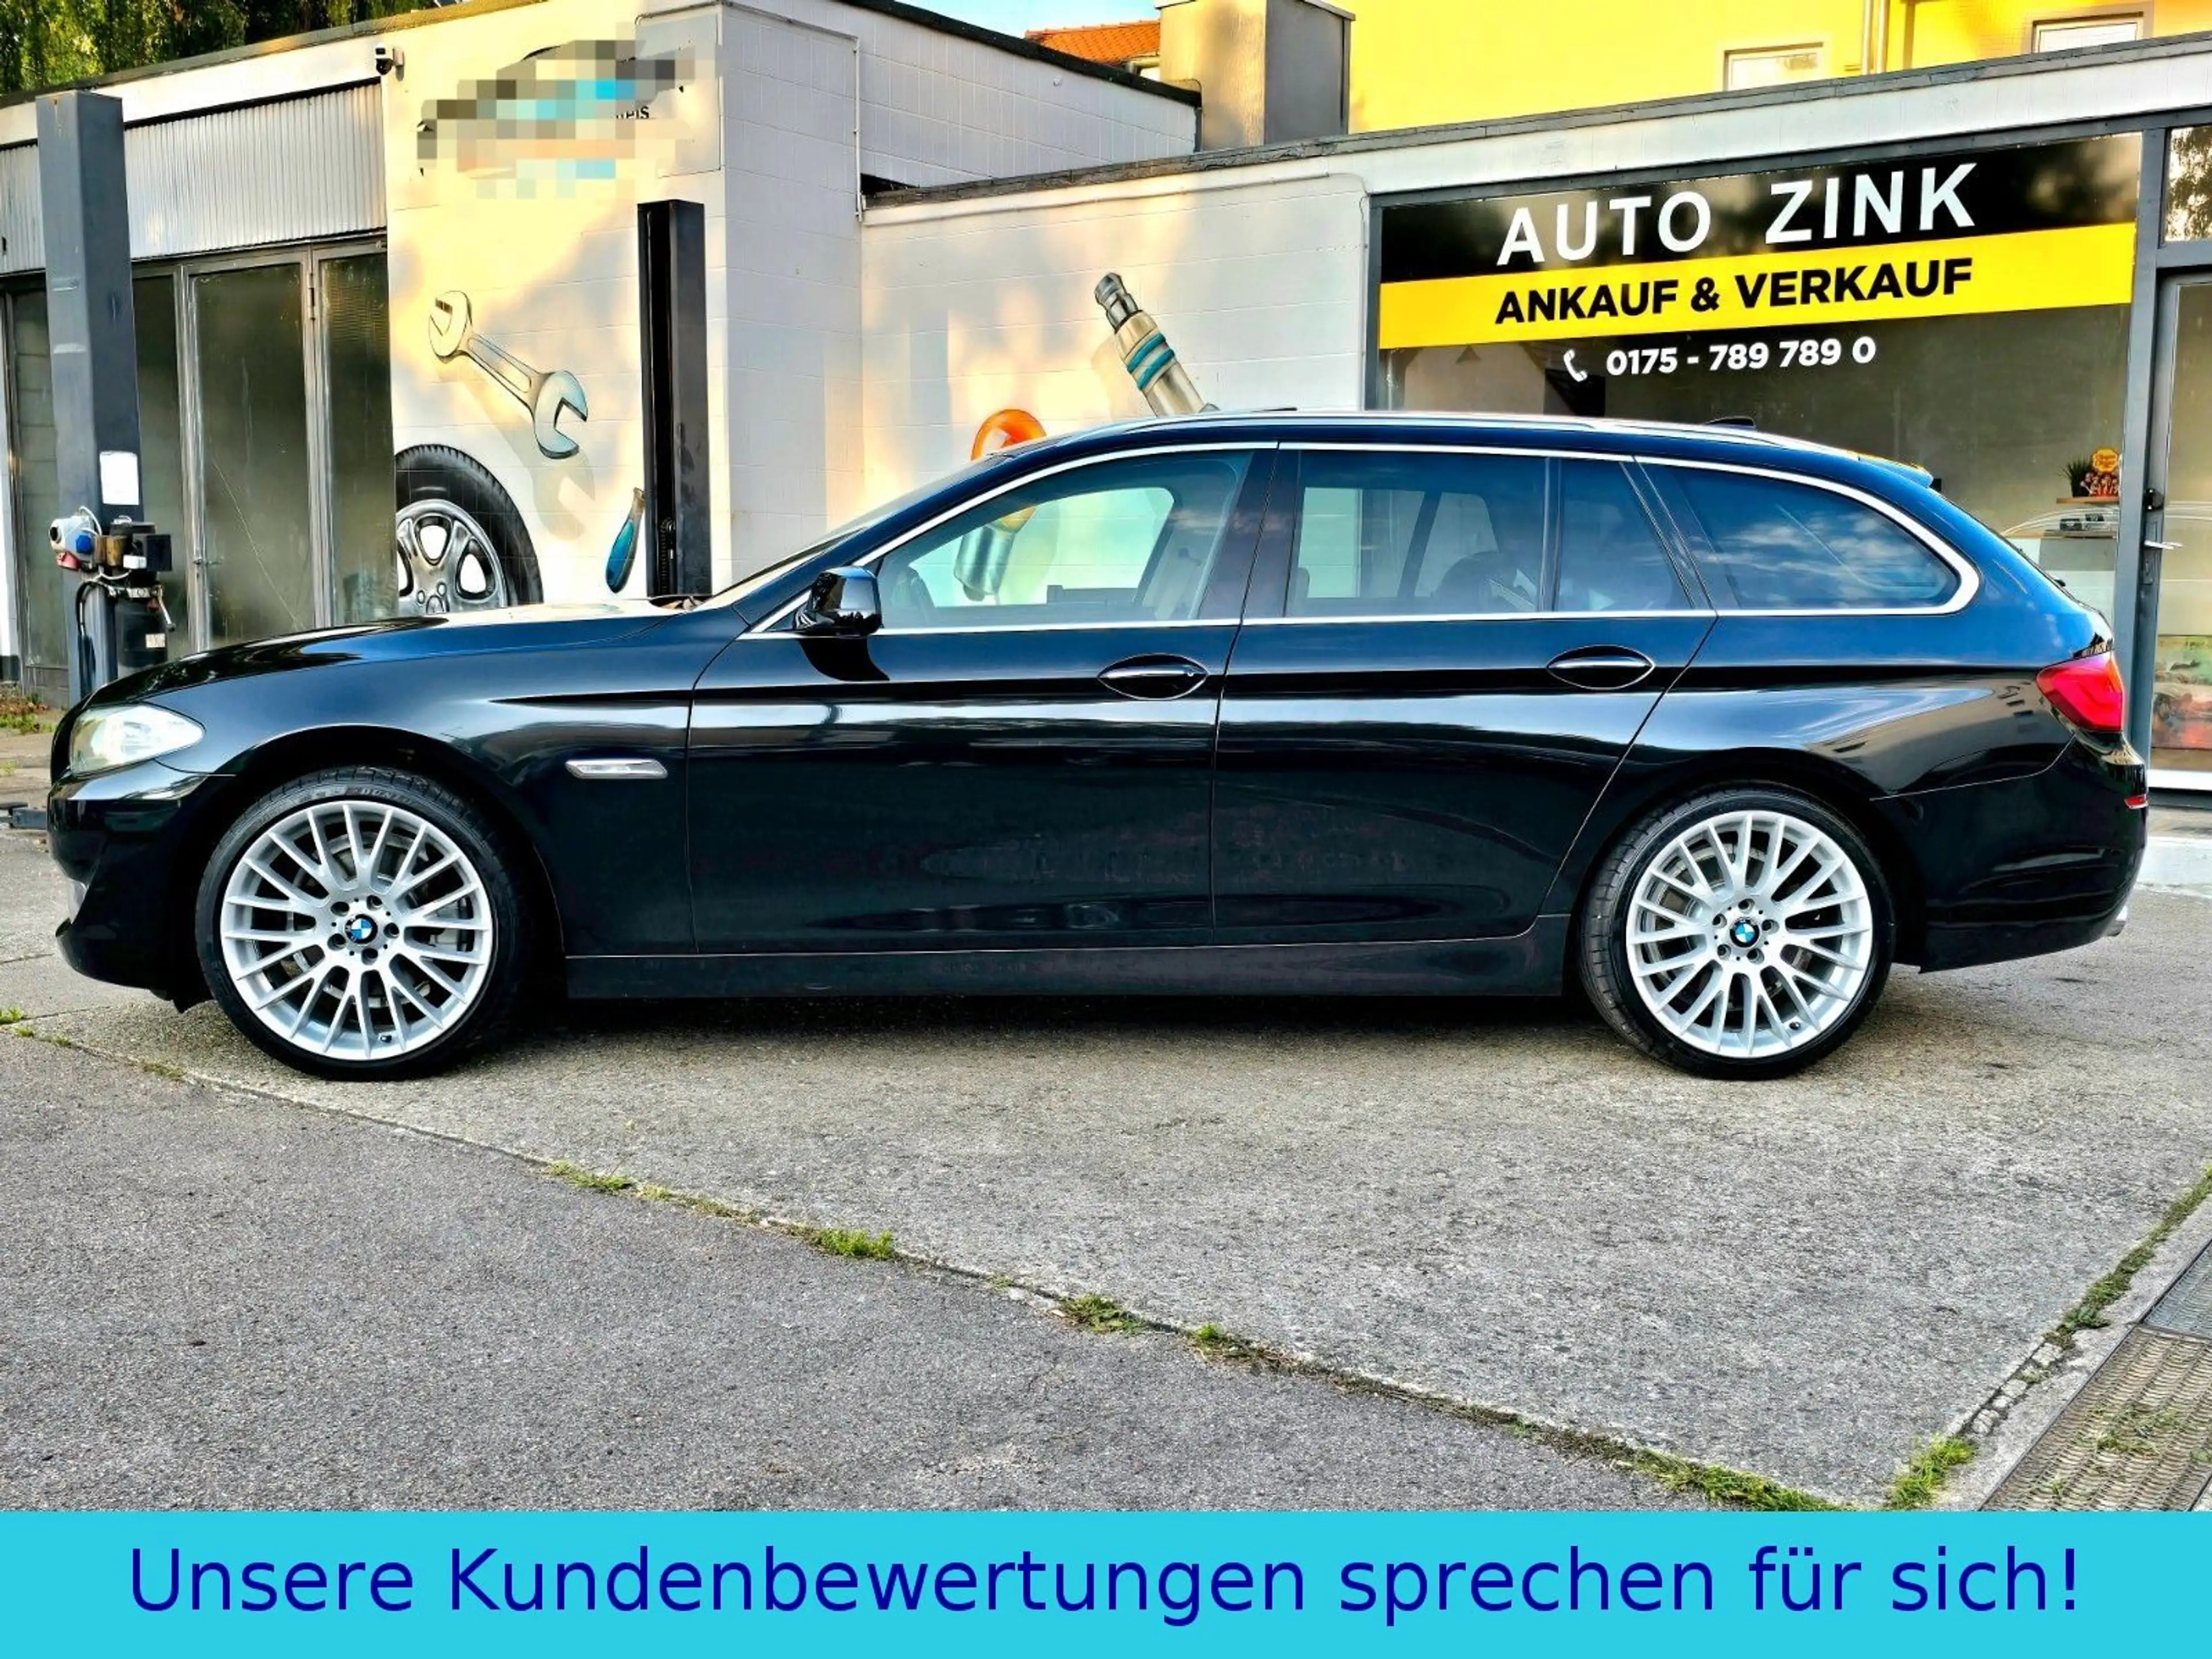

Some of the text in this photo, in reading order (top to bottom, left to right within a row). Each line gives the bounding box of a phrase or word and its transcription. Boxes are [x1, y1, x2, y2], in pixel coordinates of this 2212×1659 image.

[1496, 162, 1977, 266] AUTO ZINK
[1494, 257, 1974, 325] ANKAUF & VERKAUF
[1606, 335, 1877, 376] 0175 - 789 789 0
